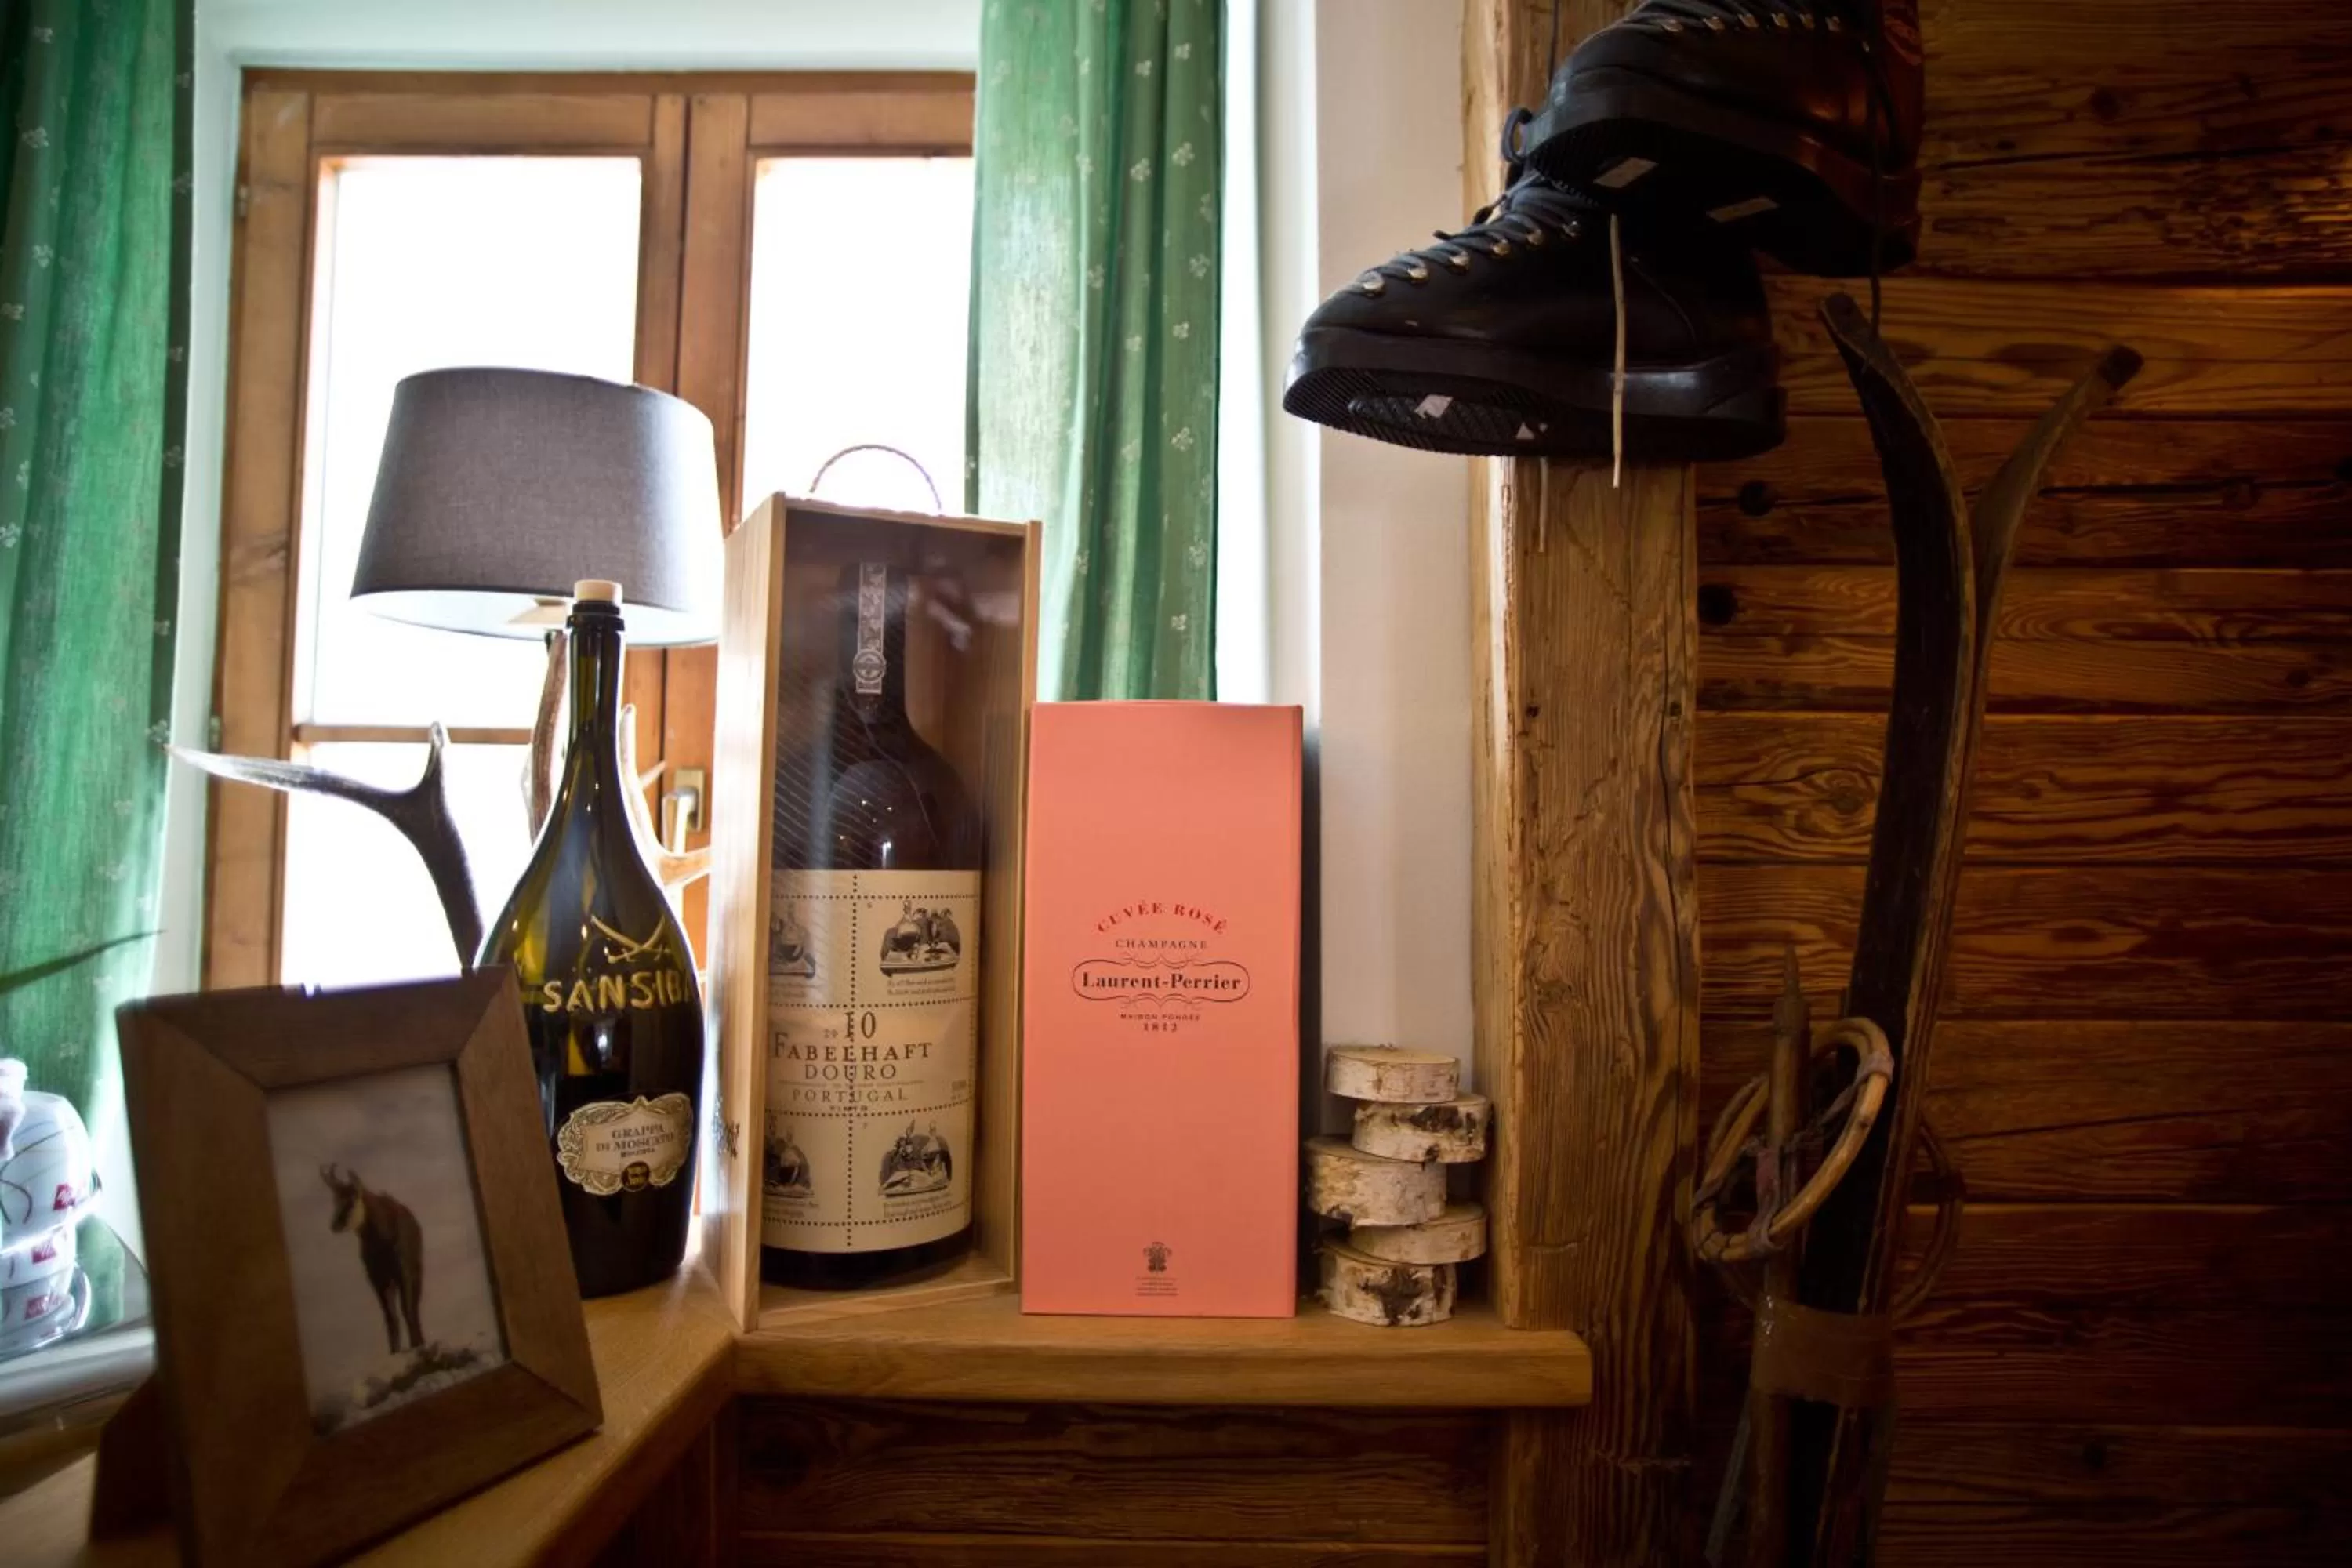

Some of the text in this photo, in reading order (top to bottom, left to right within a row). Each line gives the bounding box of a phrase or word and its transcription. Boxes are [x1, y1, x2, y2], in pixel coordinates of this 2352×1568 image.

[1097, 900, 1228, 933] CUVÉE ROSÉ
[1115, 939, 1208, 949] CHAMPAGNE
[1081, 971, 1241, 990] Laurent-Perrier
[1143, 1022, 1178, 1033] 1812
[773, 1031, 933, 1062] FABELHAFT
[804, 1063, 897, 1080] DOURO
[792, 1087, 909, 1103] PORTUGAL
[611, 1123, 666, 1139] GRAPPA
